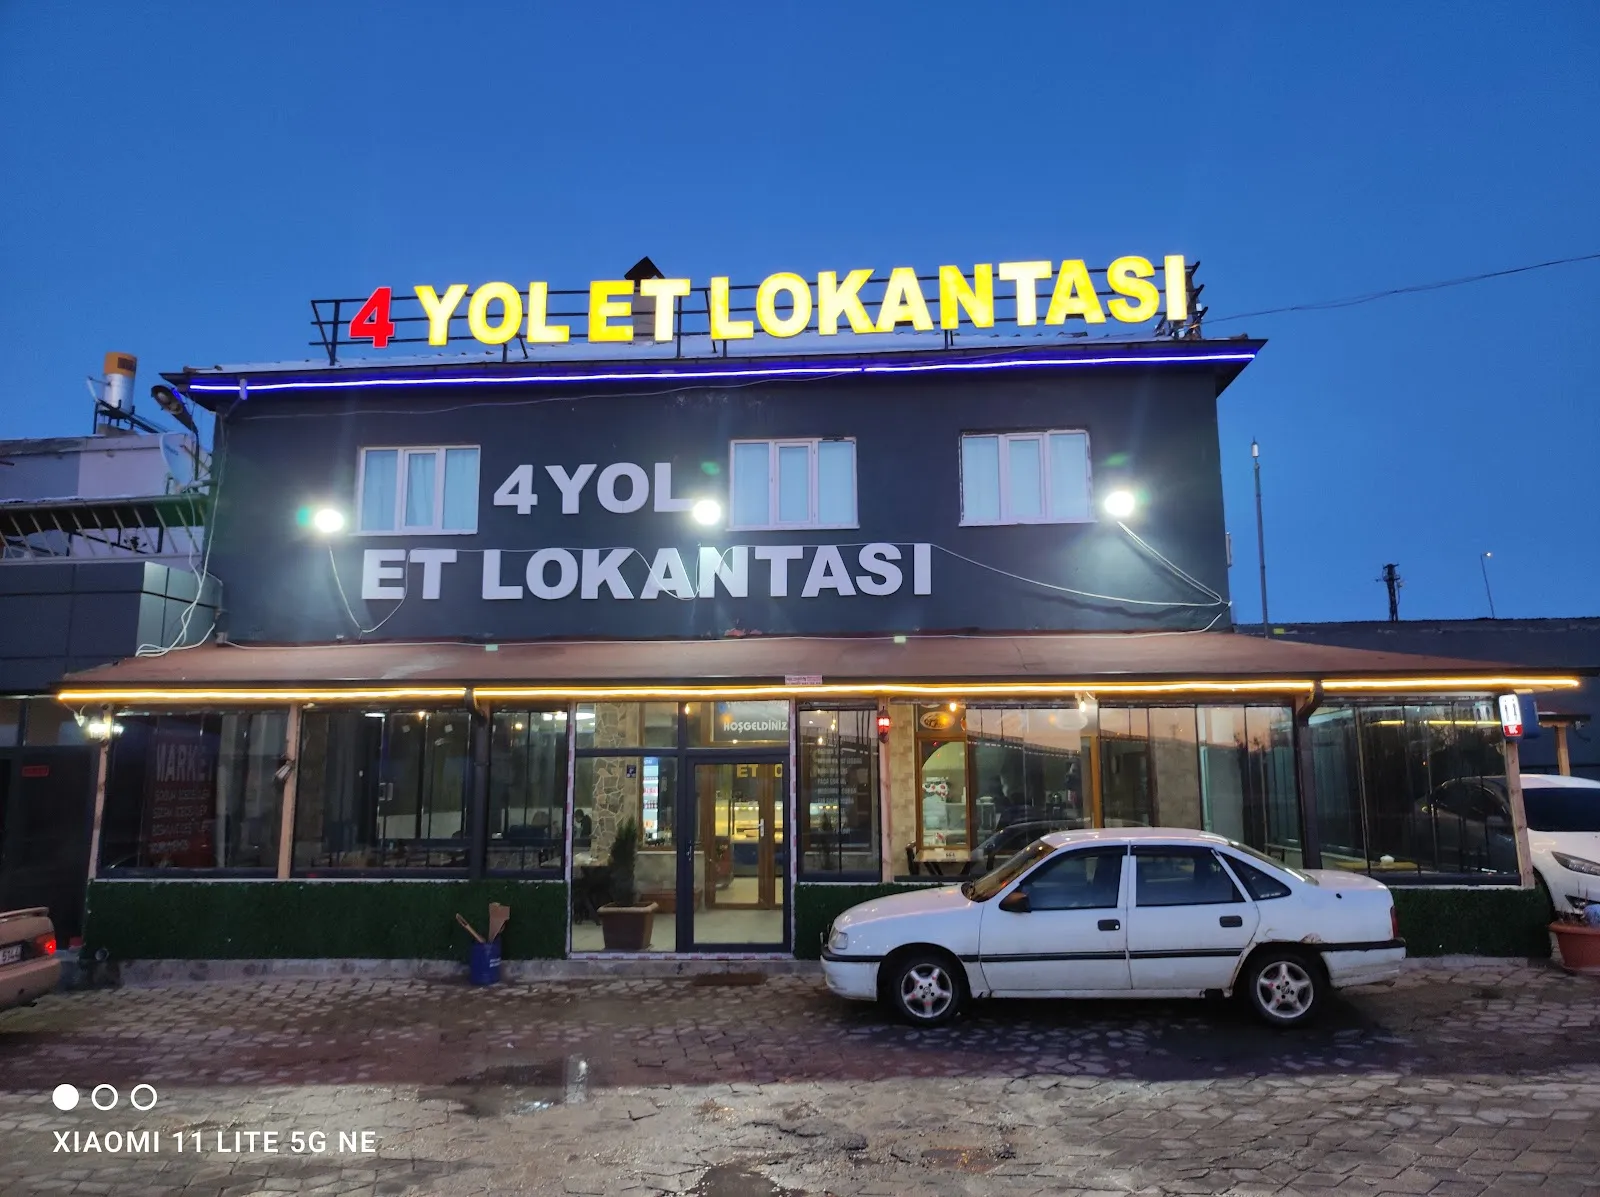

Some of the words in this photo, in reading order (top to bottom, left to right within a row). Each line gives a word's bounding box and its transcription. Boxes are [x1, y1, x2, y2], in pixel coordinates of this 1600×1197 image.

[348, 286, 395, 348] 4
[414, 281, 570, 346] YOL
[588, 278, 691, 342] ET
[710, 254, 1188, 341] LOKANTASI
[493, 463, 538, 515] 4
[544, 462, 698, 515] YOL
[361, 548, 458, 600] ET
[482, 542, 932, 601] LOKANTASI
